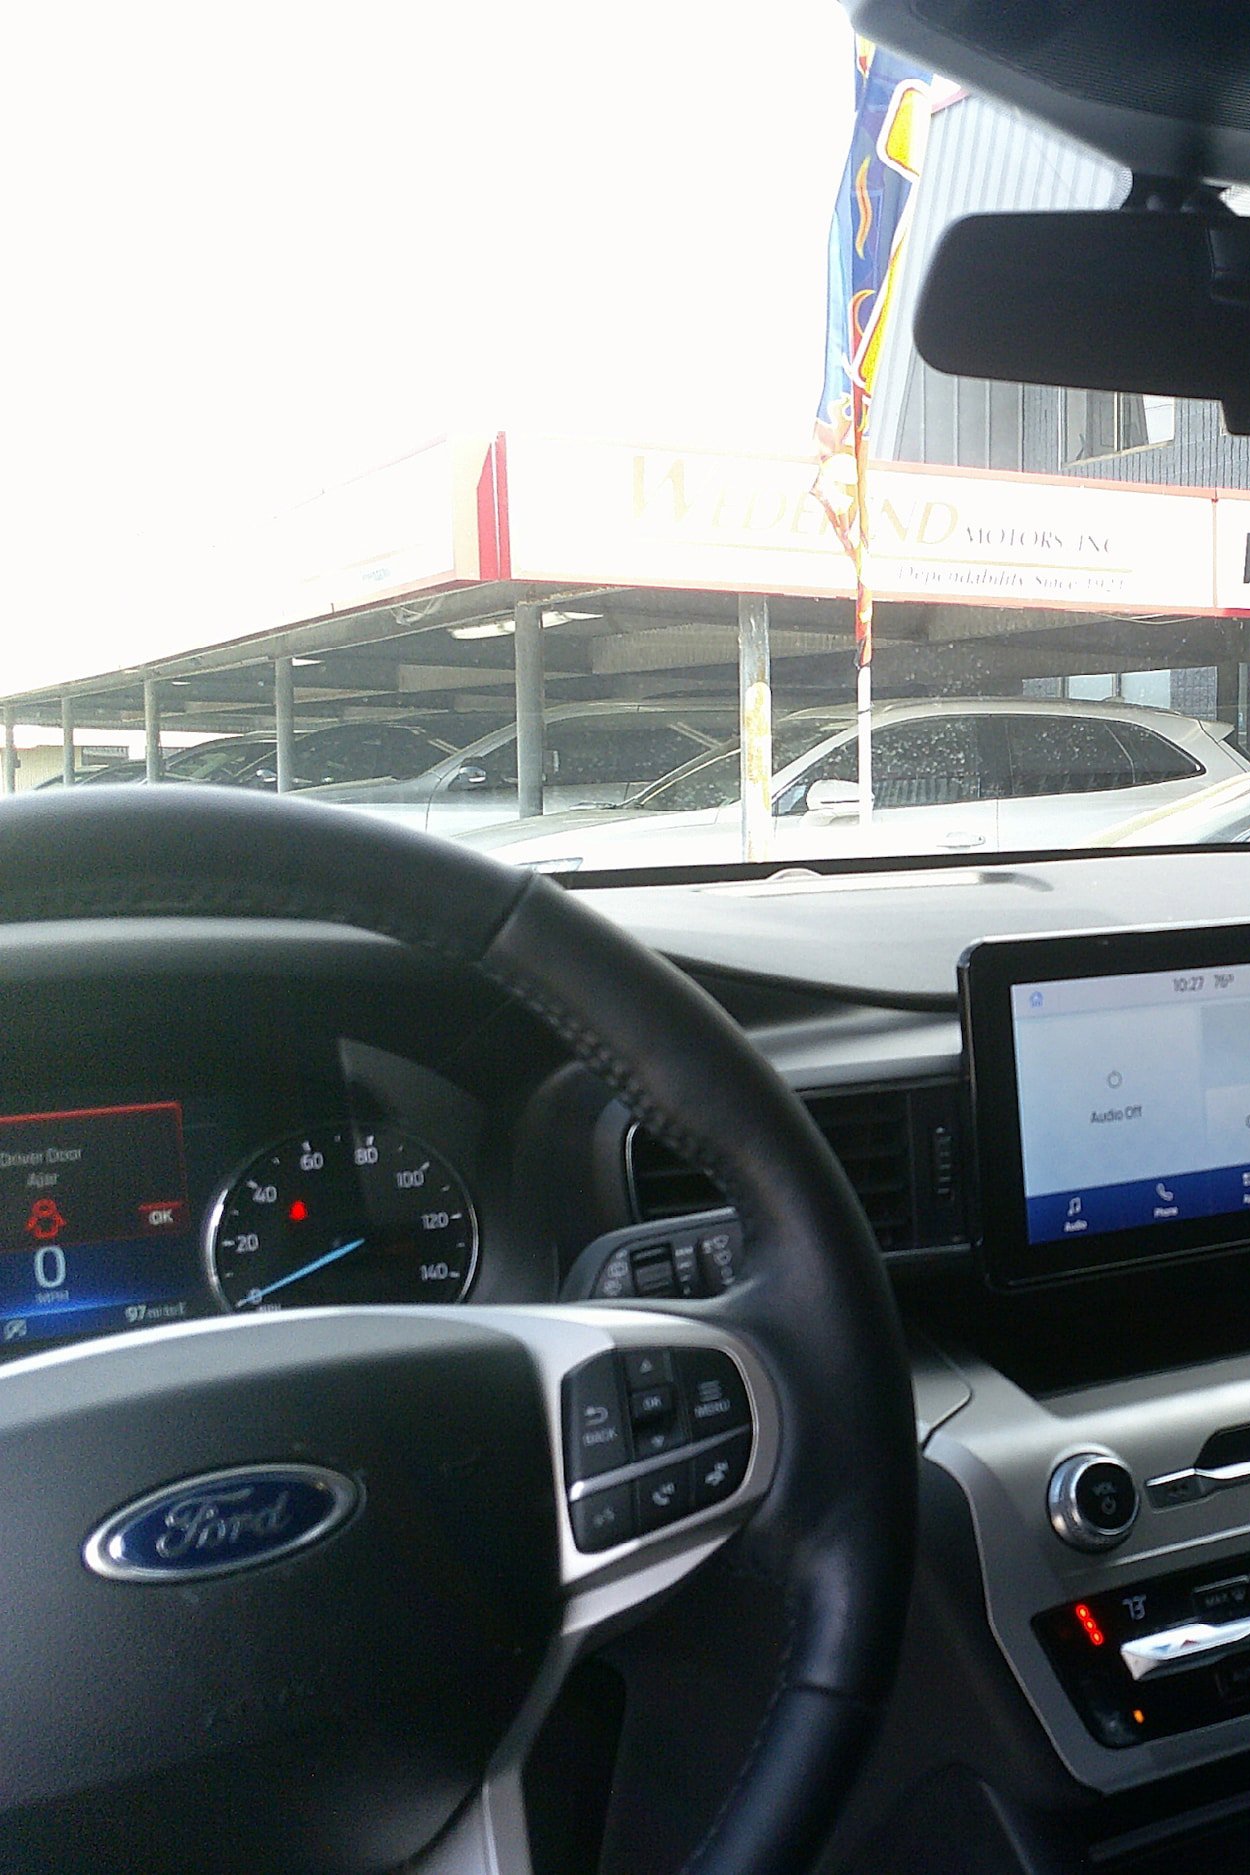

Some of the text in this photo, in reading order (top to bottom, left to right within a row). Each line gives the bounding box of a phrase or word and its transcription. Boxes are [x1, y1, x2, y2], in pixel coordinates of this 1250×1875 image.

[1173, 975, 1205, 993] 10:27
[1090, 1105, 1143, 1124] Audio Off
[300, 1151, 324, 1171] 60
[354, 1146, 379, 1166] 80
[396, 1170, 425, 1189] 100
[252, 1185, 278, 1204] 40
[149, 1208, 174, 1226] OK
[421, 1211, 450, 1230] 120
[235, 1233, 260, 1253] 20
[34, 1245, 66, 1289] 0
[419, 1262, 450, 1281] 140
[124, 1303, 147, 1323] 97
[693, 1398, 731, 1419] MENU
[154, 1486, 292, 1560] Ford
